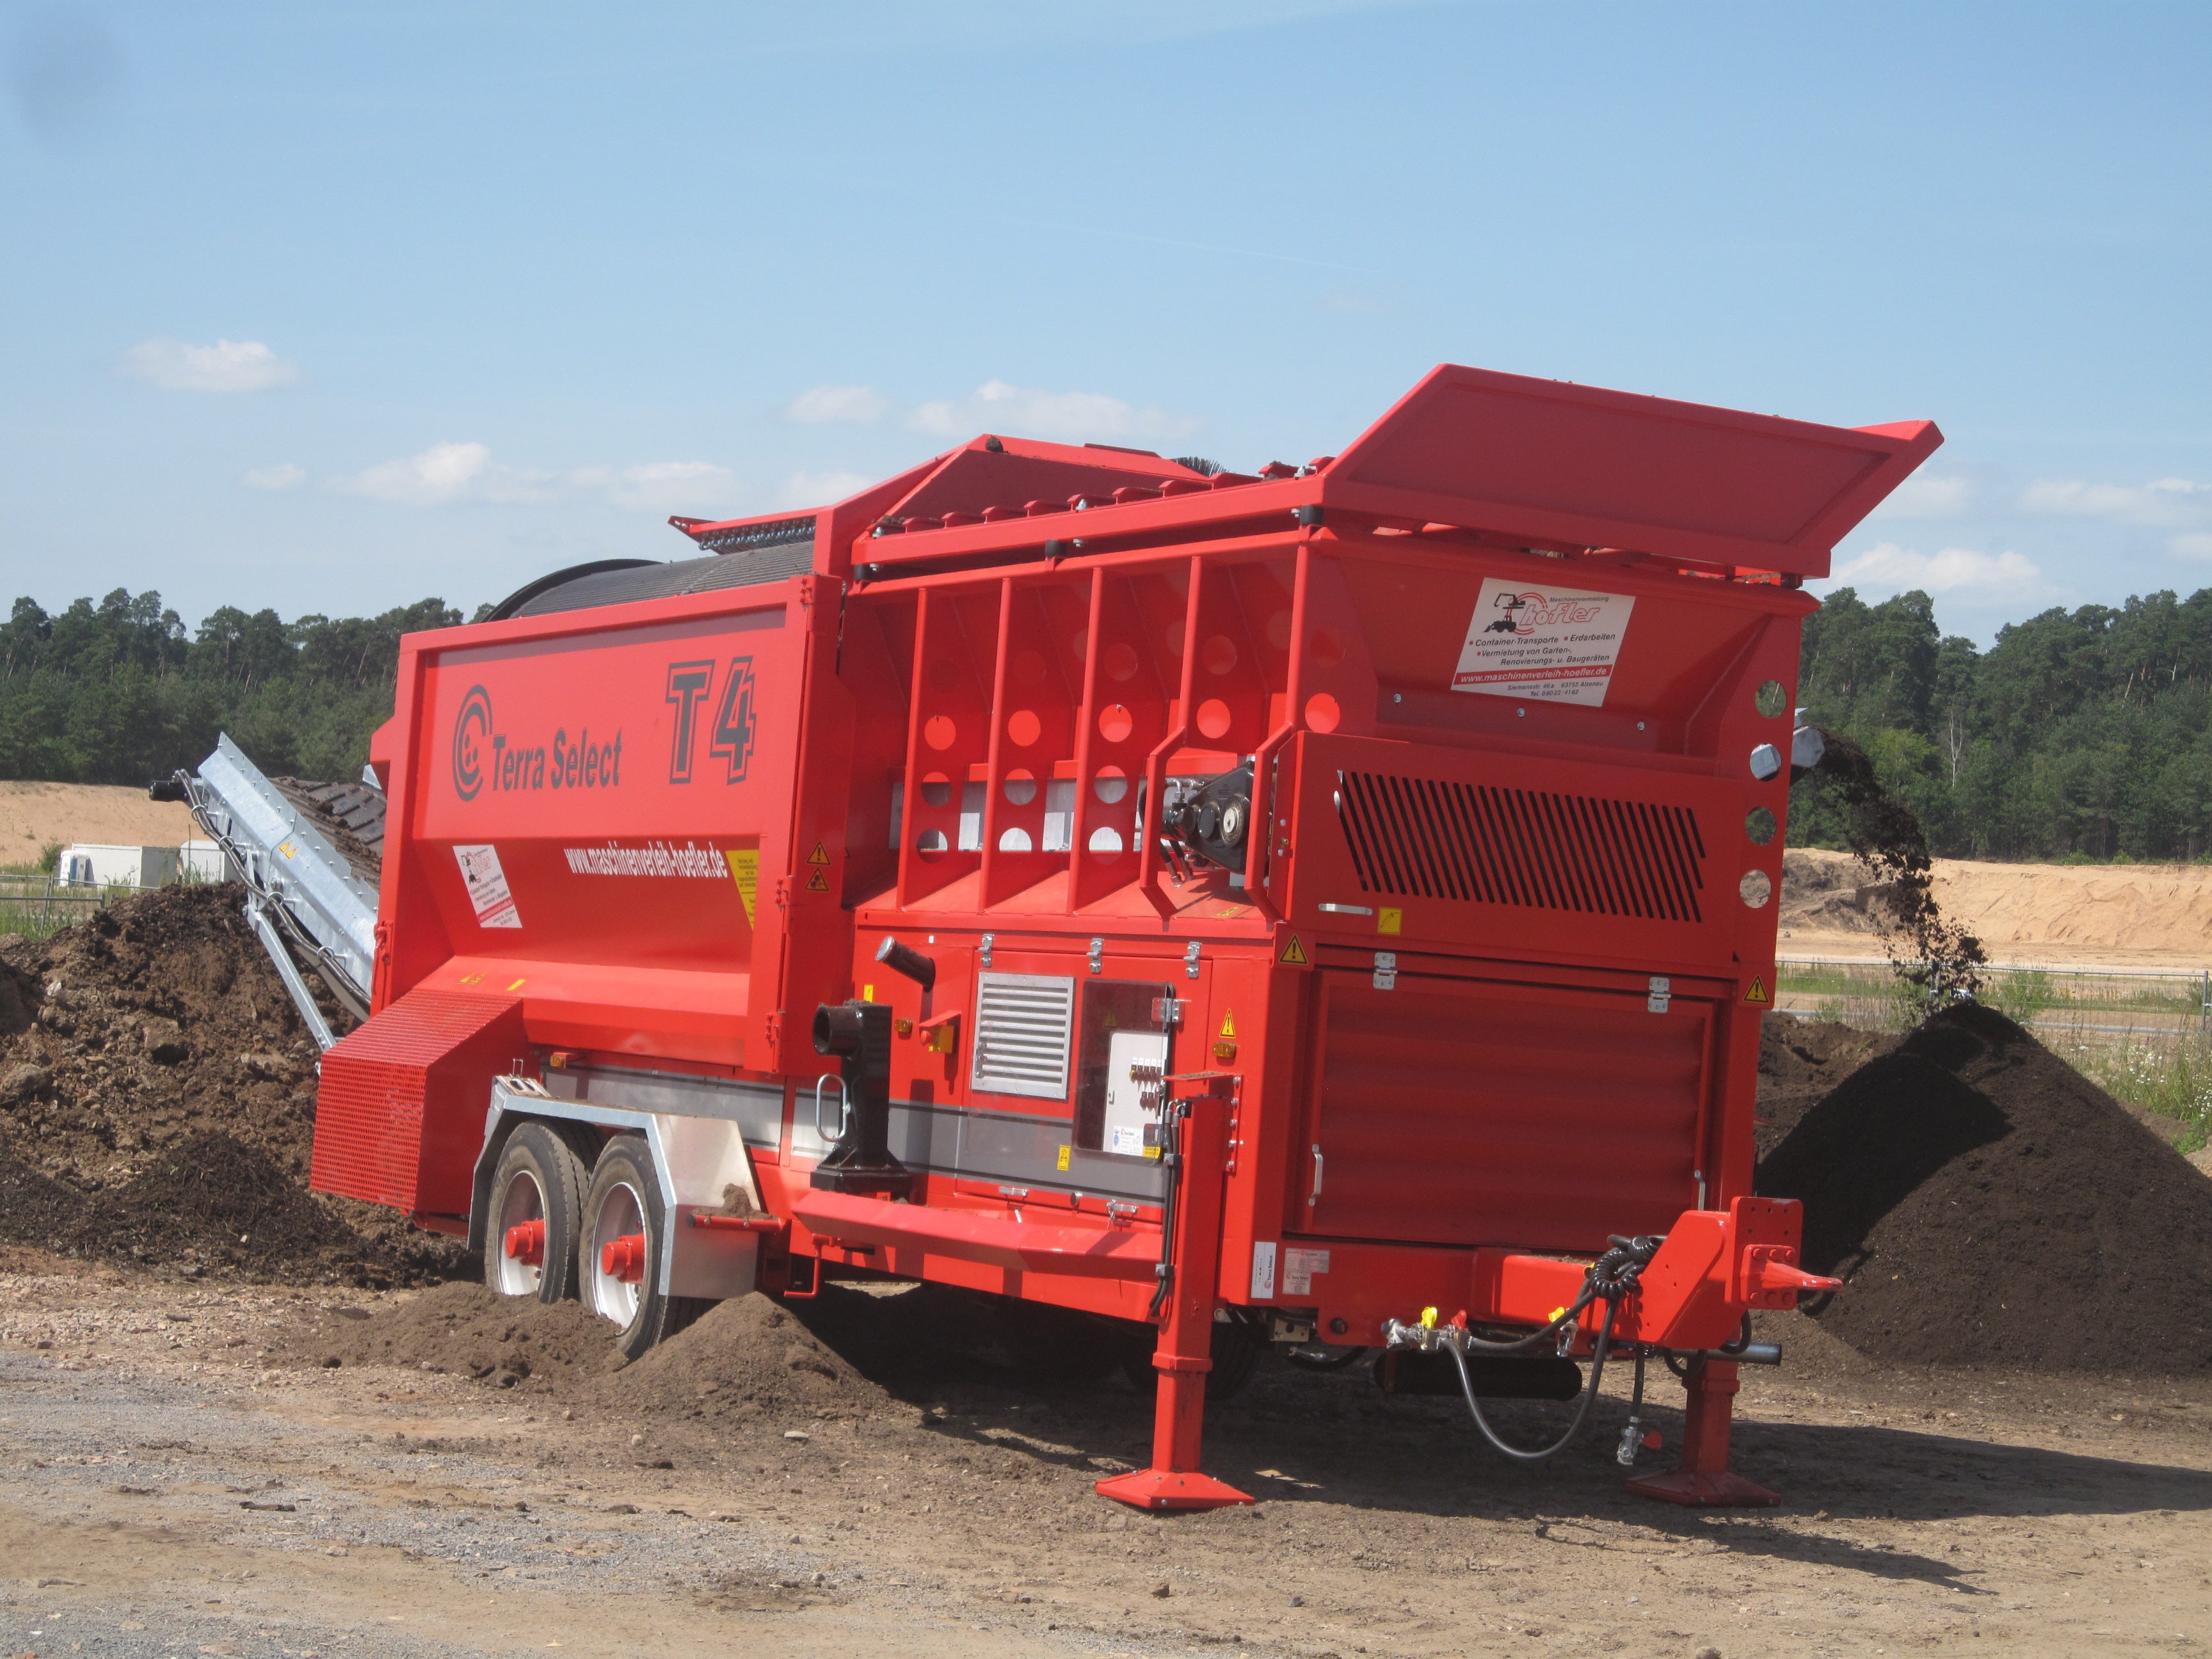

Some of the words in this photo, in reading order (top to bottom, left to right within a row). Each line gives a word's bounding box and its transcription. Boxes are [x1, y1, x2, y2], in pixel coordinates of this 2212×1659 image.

[1475, 636, 1559, 646] Container-Transporte
[1570, 633, 1615, 641] Erdarbeiten
[1482, 648, 1525, 657] Vermietung
[1500, 656, 1555, 666] Renovierungs-
[1566, 654, 1610, 663] Baugeräten
[1461, 668, 1607, 682] www.maschinenverleih-hoefler.de
[665, 655, 757, 785] T4
[493, 734, 545, 791] Terra
[550, 727, 622, 789] Select
[563, 840, 728, 878] www.maschinenverleih-hoefler.de
